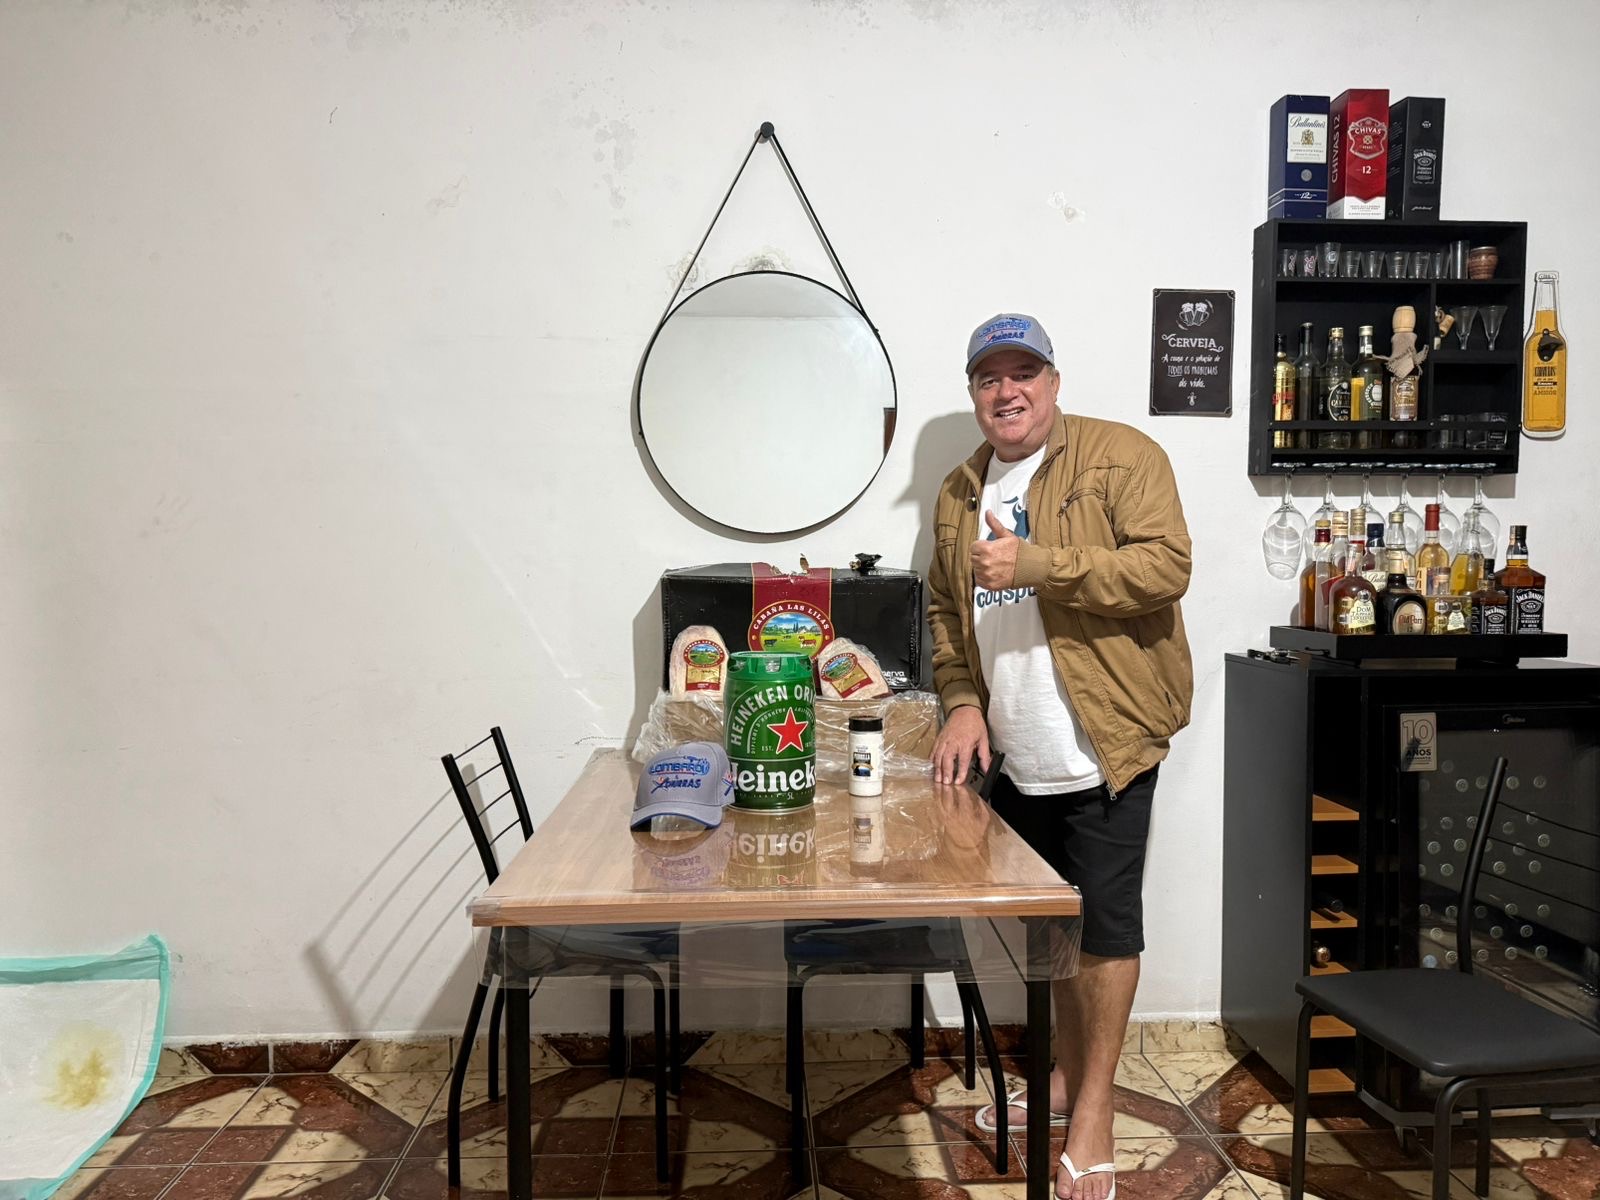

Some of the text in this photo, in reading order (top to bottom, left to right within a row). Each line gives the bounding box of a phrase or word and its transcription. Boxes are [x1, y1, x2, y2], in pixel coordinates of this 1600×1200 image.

[1354, 127, 1381, 135] CHIVAS
[1331, 114, 1340, 183] CHIVAS 12
[1362, 166, 1372, 174] 12
[1168, 337, 1217, 348] CERVEJA
[807, 608, 830, 630] LILAS
[730, 685, 788, 746] HEINEKEN
[793, 684, 816, 704] ORI
[1402, 718, 1434, 745] 10
[1405, 748, 1432, 756] ANOS
